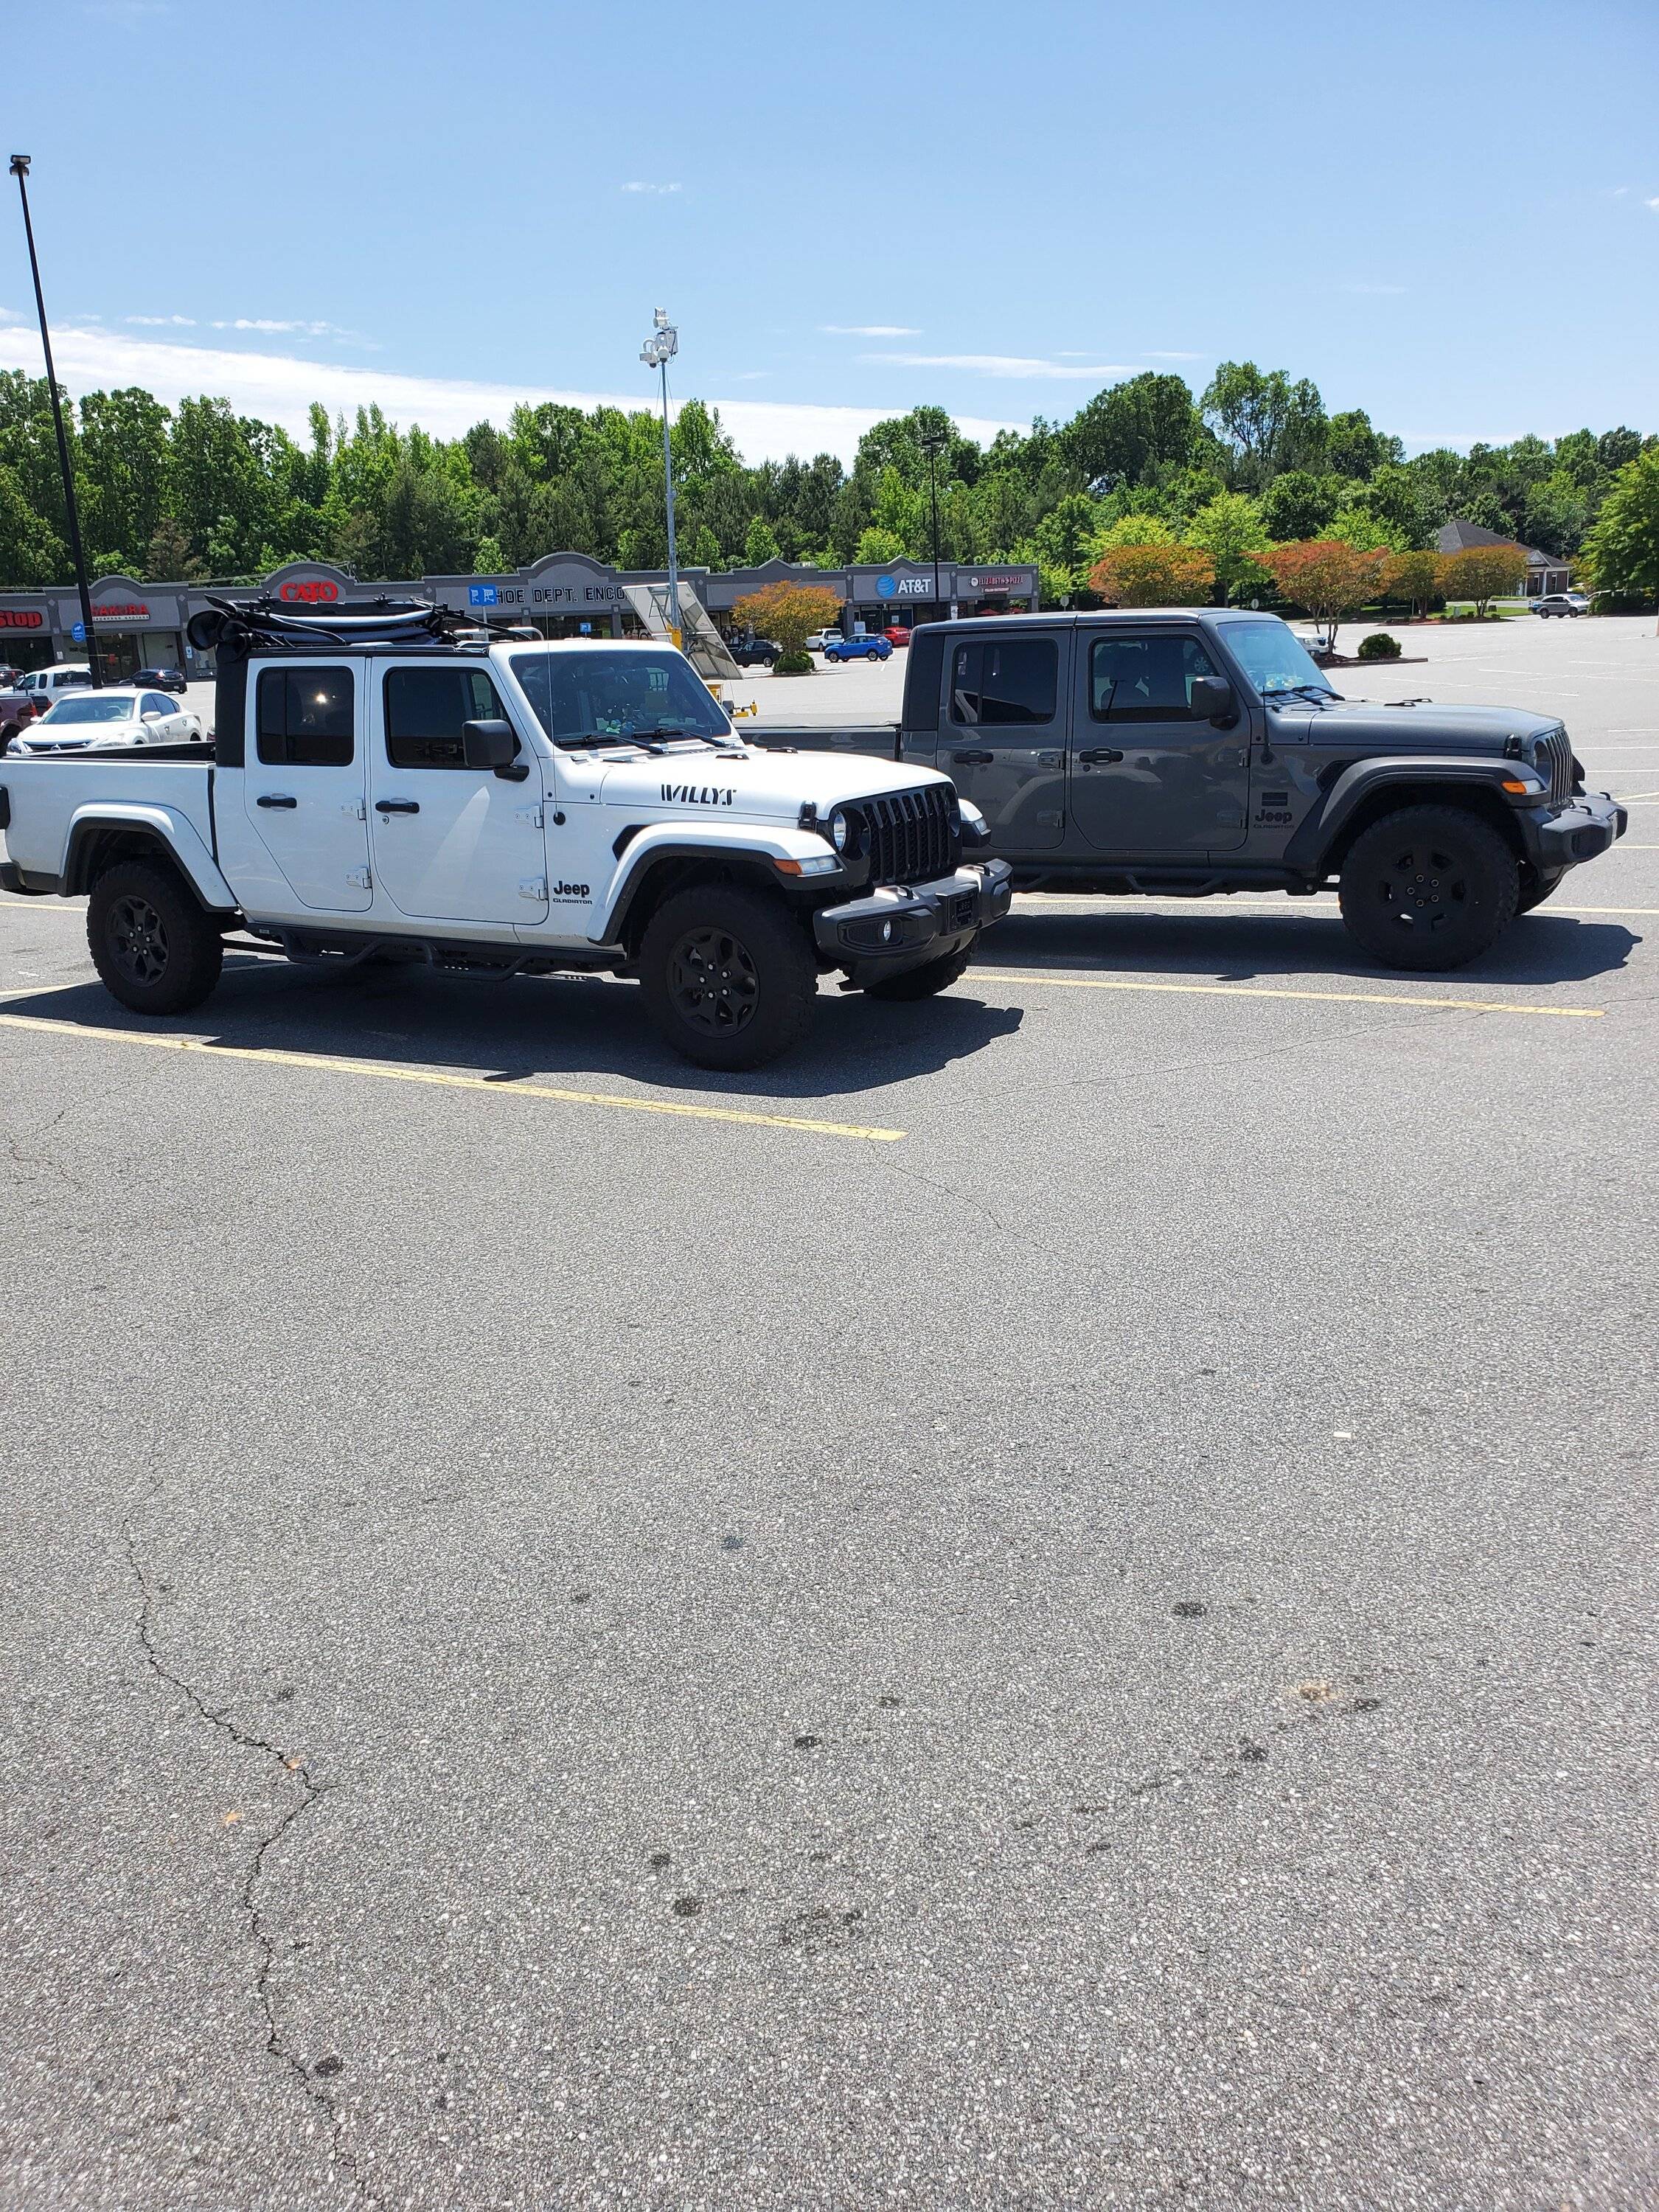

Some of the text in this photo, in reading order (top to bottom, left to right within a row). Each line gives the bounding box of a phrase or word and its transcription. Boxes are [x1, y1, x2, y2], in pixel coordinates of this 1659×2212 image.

[279, 580, 338, 602] CATO
[496, 585, 626, 604] HOE DEPT. ENCO
[897, 579, 931, 594] AT&T
[91, 603, 150, 616] SAKURA
[0, 610, 42, 628] Stop
[661, 784, 737, 806] WILLYS
[1255, 809, 1293, 824] Jeep
[553, 880, 590, 898] Jeep
